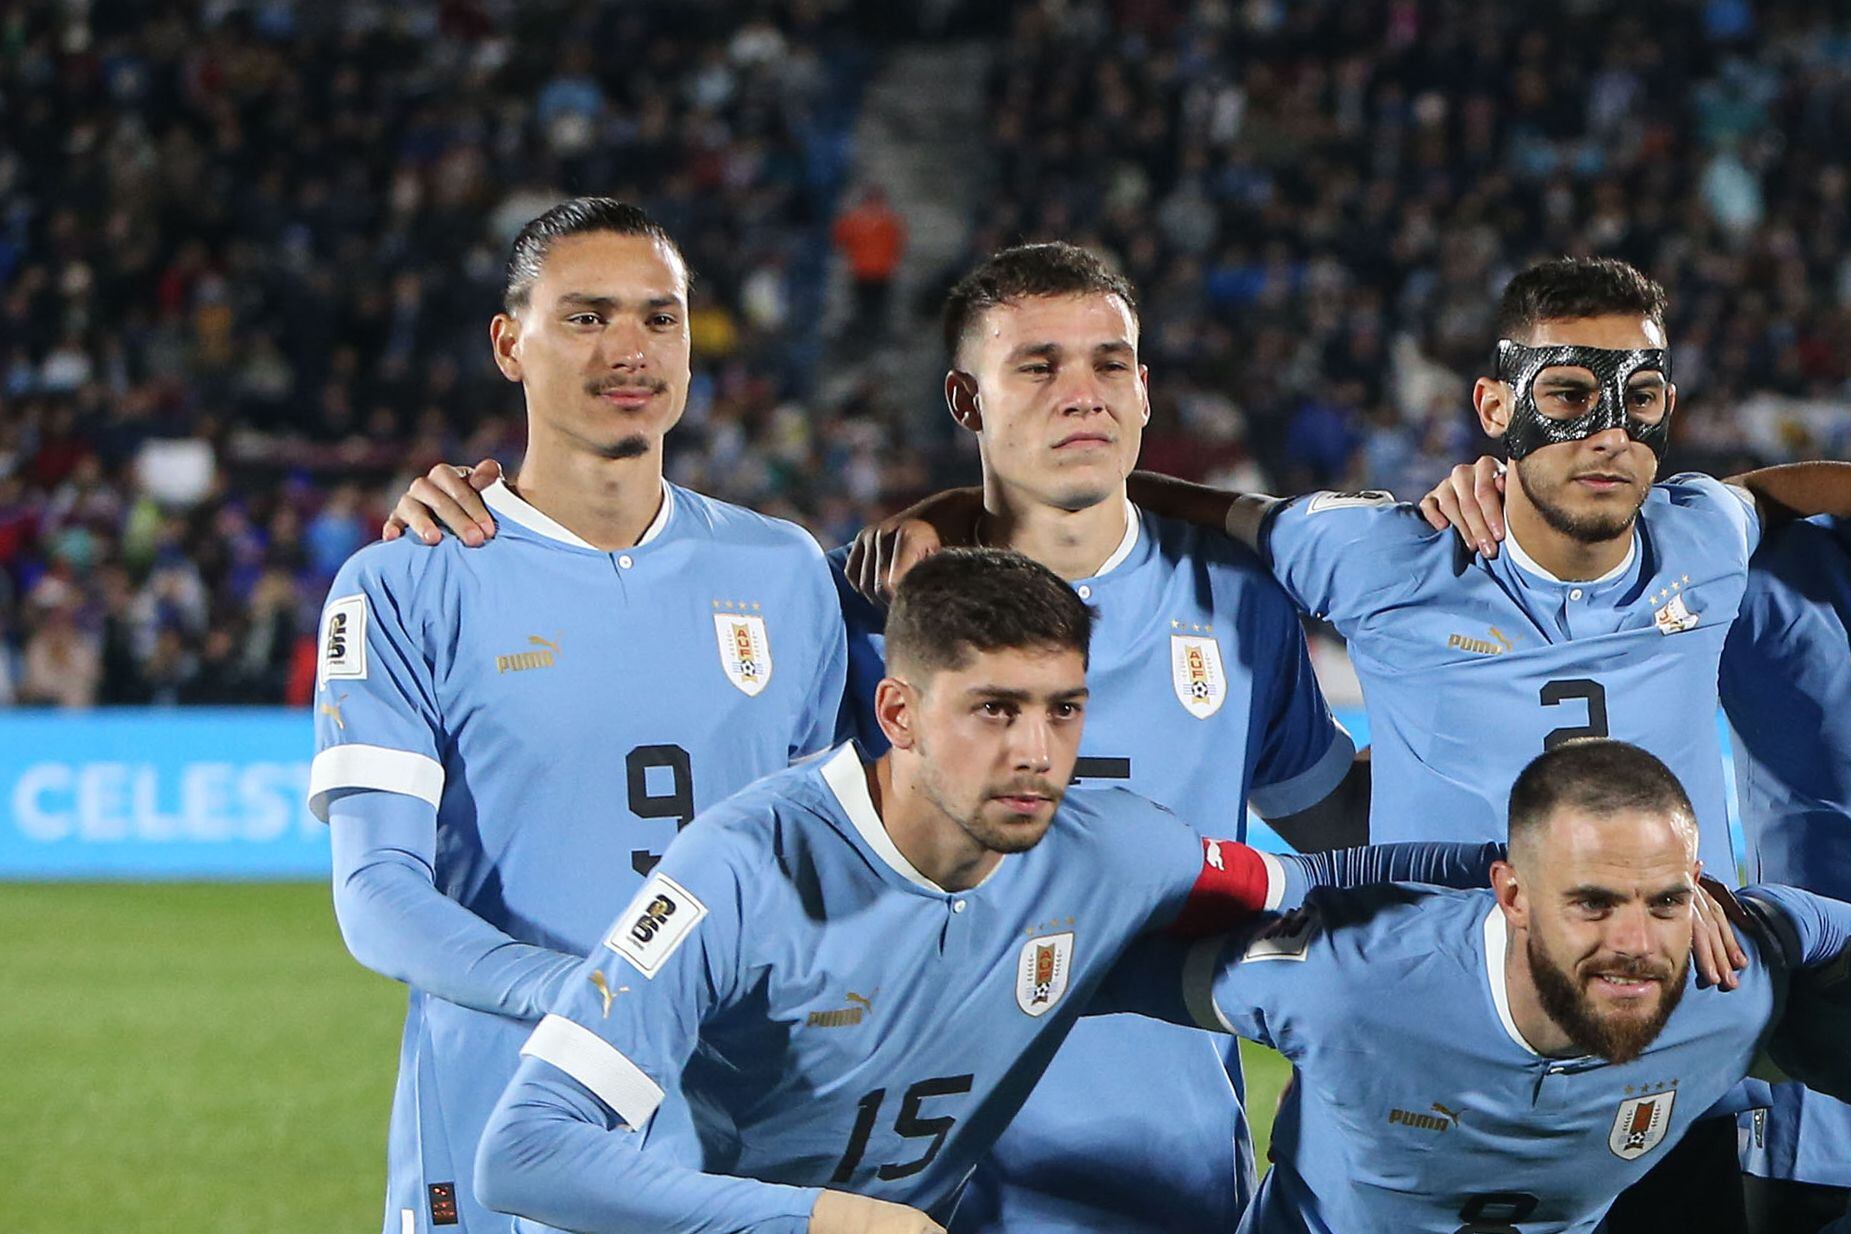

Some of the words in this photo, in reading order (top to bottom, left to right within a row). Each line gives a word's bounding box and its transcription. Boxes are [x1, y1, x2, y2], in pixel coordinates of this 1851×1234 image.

[1190, 651, 1204, 679] AUF
[1540, 678, 1609, 754] 2
[626, 744, 694, 878] 9
[829, 1073, 974, 1184] 15
[1389, 1108, 1449, 1131] PUMA
